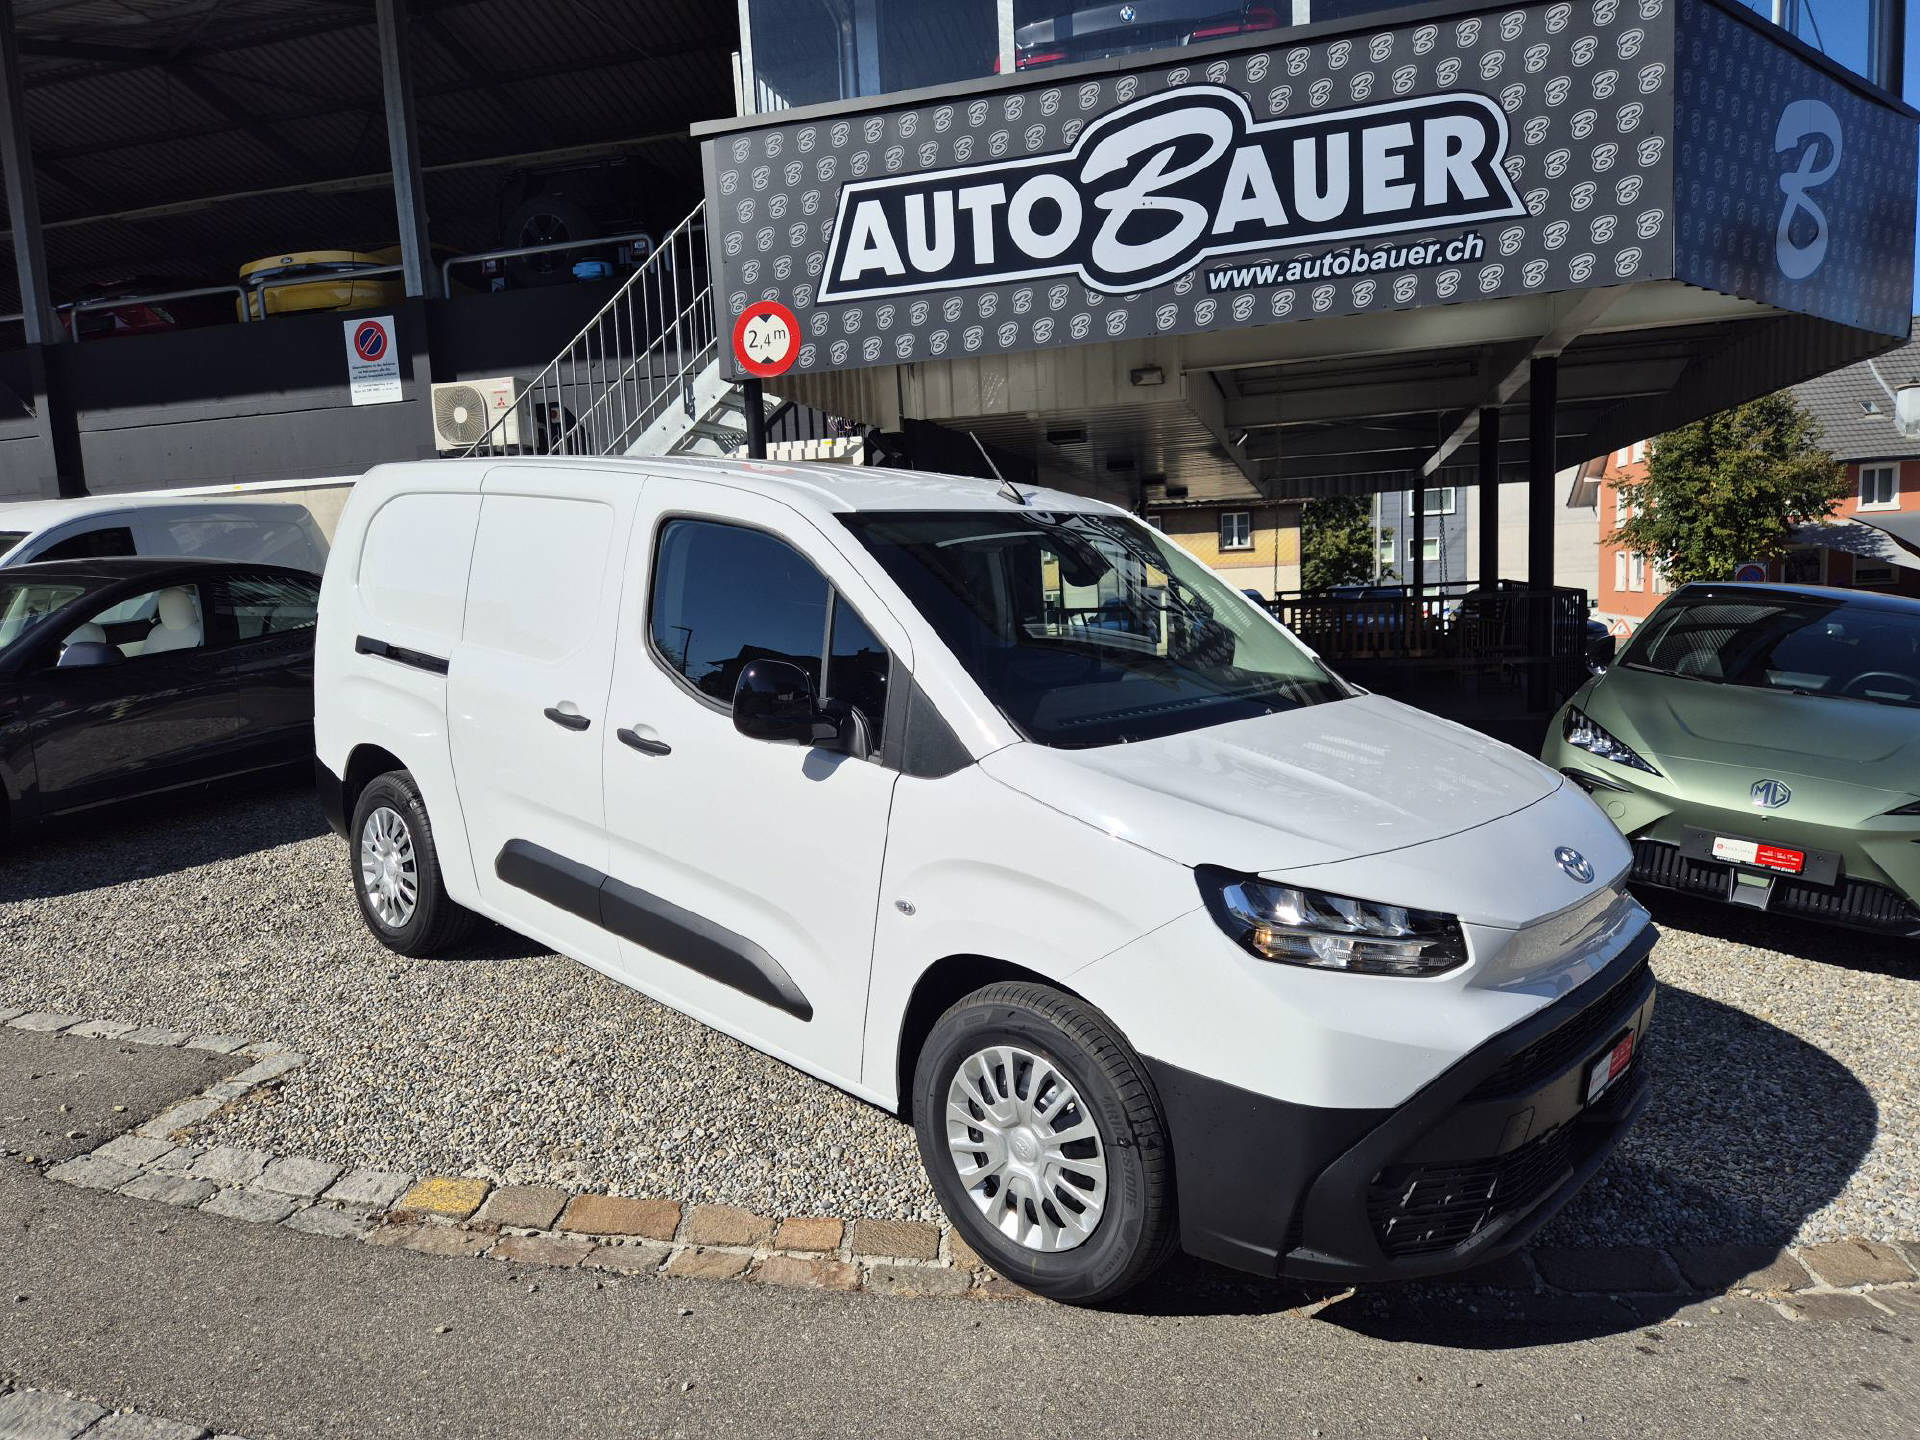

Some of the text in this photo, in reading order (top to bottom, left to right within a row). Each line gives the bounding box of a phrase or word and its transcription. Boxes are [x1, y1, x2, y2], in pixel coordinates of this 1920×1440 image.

[840, 107, 1489, 281] AUTO BAUER
[1209, 233, 1484, 290] www.autobauer.ch
[1753, 781, 1788, 807] MG
